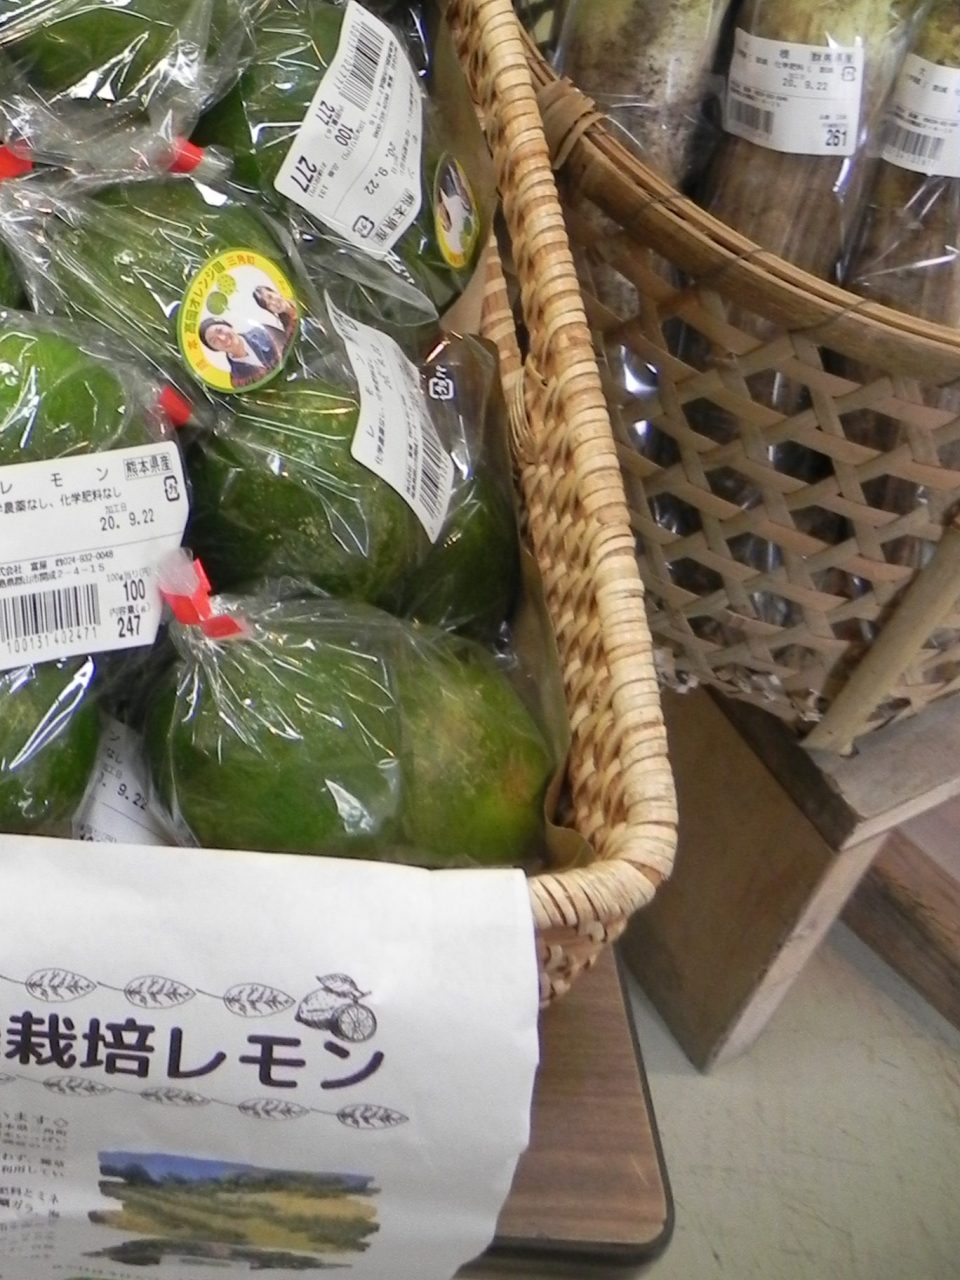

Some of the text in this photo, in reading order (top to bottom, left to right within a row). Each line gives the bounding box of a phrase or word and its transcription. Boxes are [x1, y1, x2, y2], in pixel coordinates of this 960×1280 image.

[315, 100, 336, 126] 277
[334, 123, 354, 147] 100
[825, 129, 848, 147] 261
[290, 155, 317, 193] 277
[125, 457, 173, 479] 熊本県産
[123, 578, 146, 602] 100
[117, 614, 141, 638] 247
